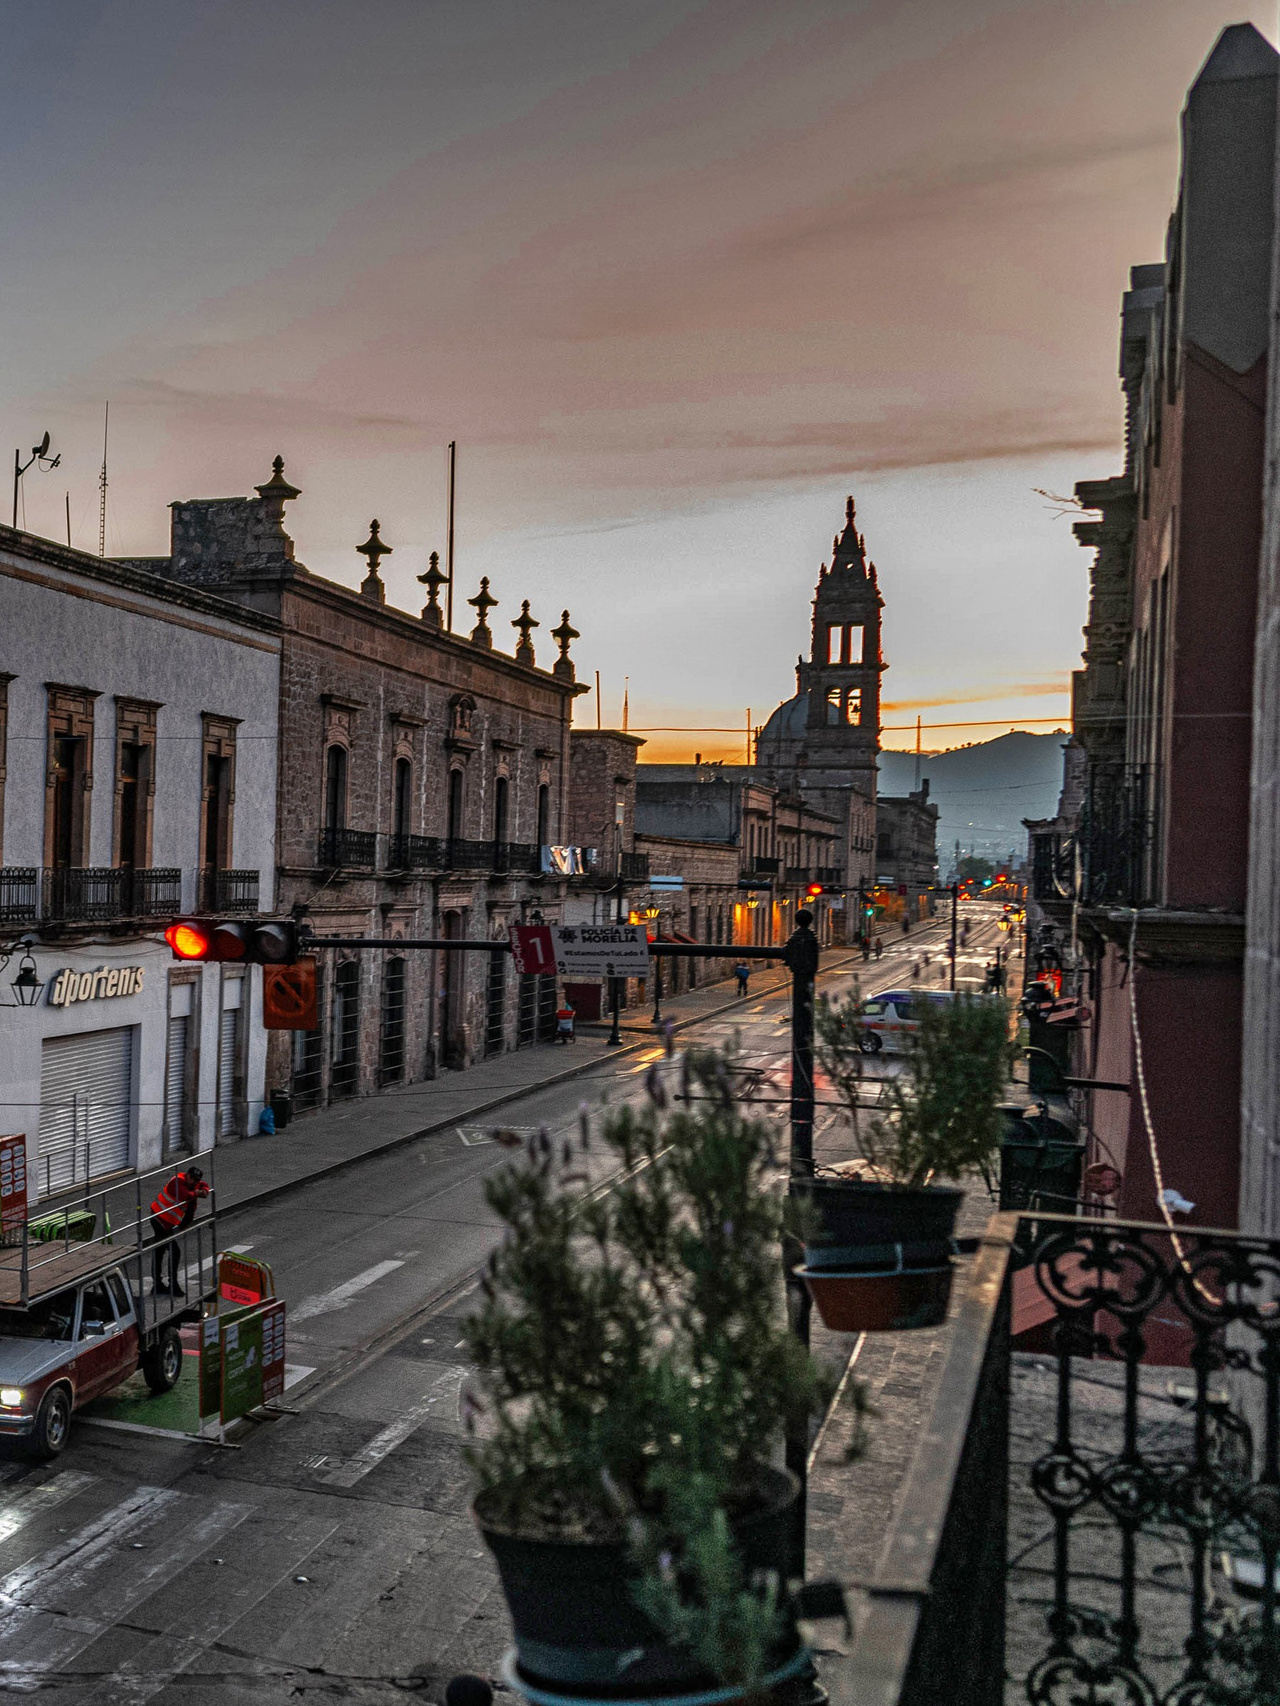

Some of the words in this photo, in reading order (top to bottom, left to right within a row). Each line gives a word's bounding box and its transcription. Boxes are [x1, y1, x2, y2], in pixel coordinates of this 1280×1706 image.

[581, 927, 621, 935] POLICÍA
[582, 935, 638, 943] MORELIA
[510, 927, 526, 973] SECTOR
[529, 937, 544, 964] 1
[51, 965, 145, 1007] dportenis
